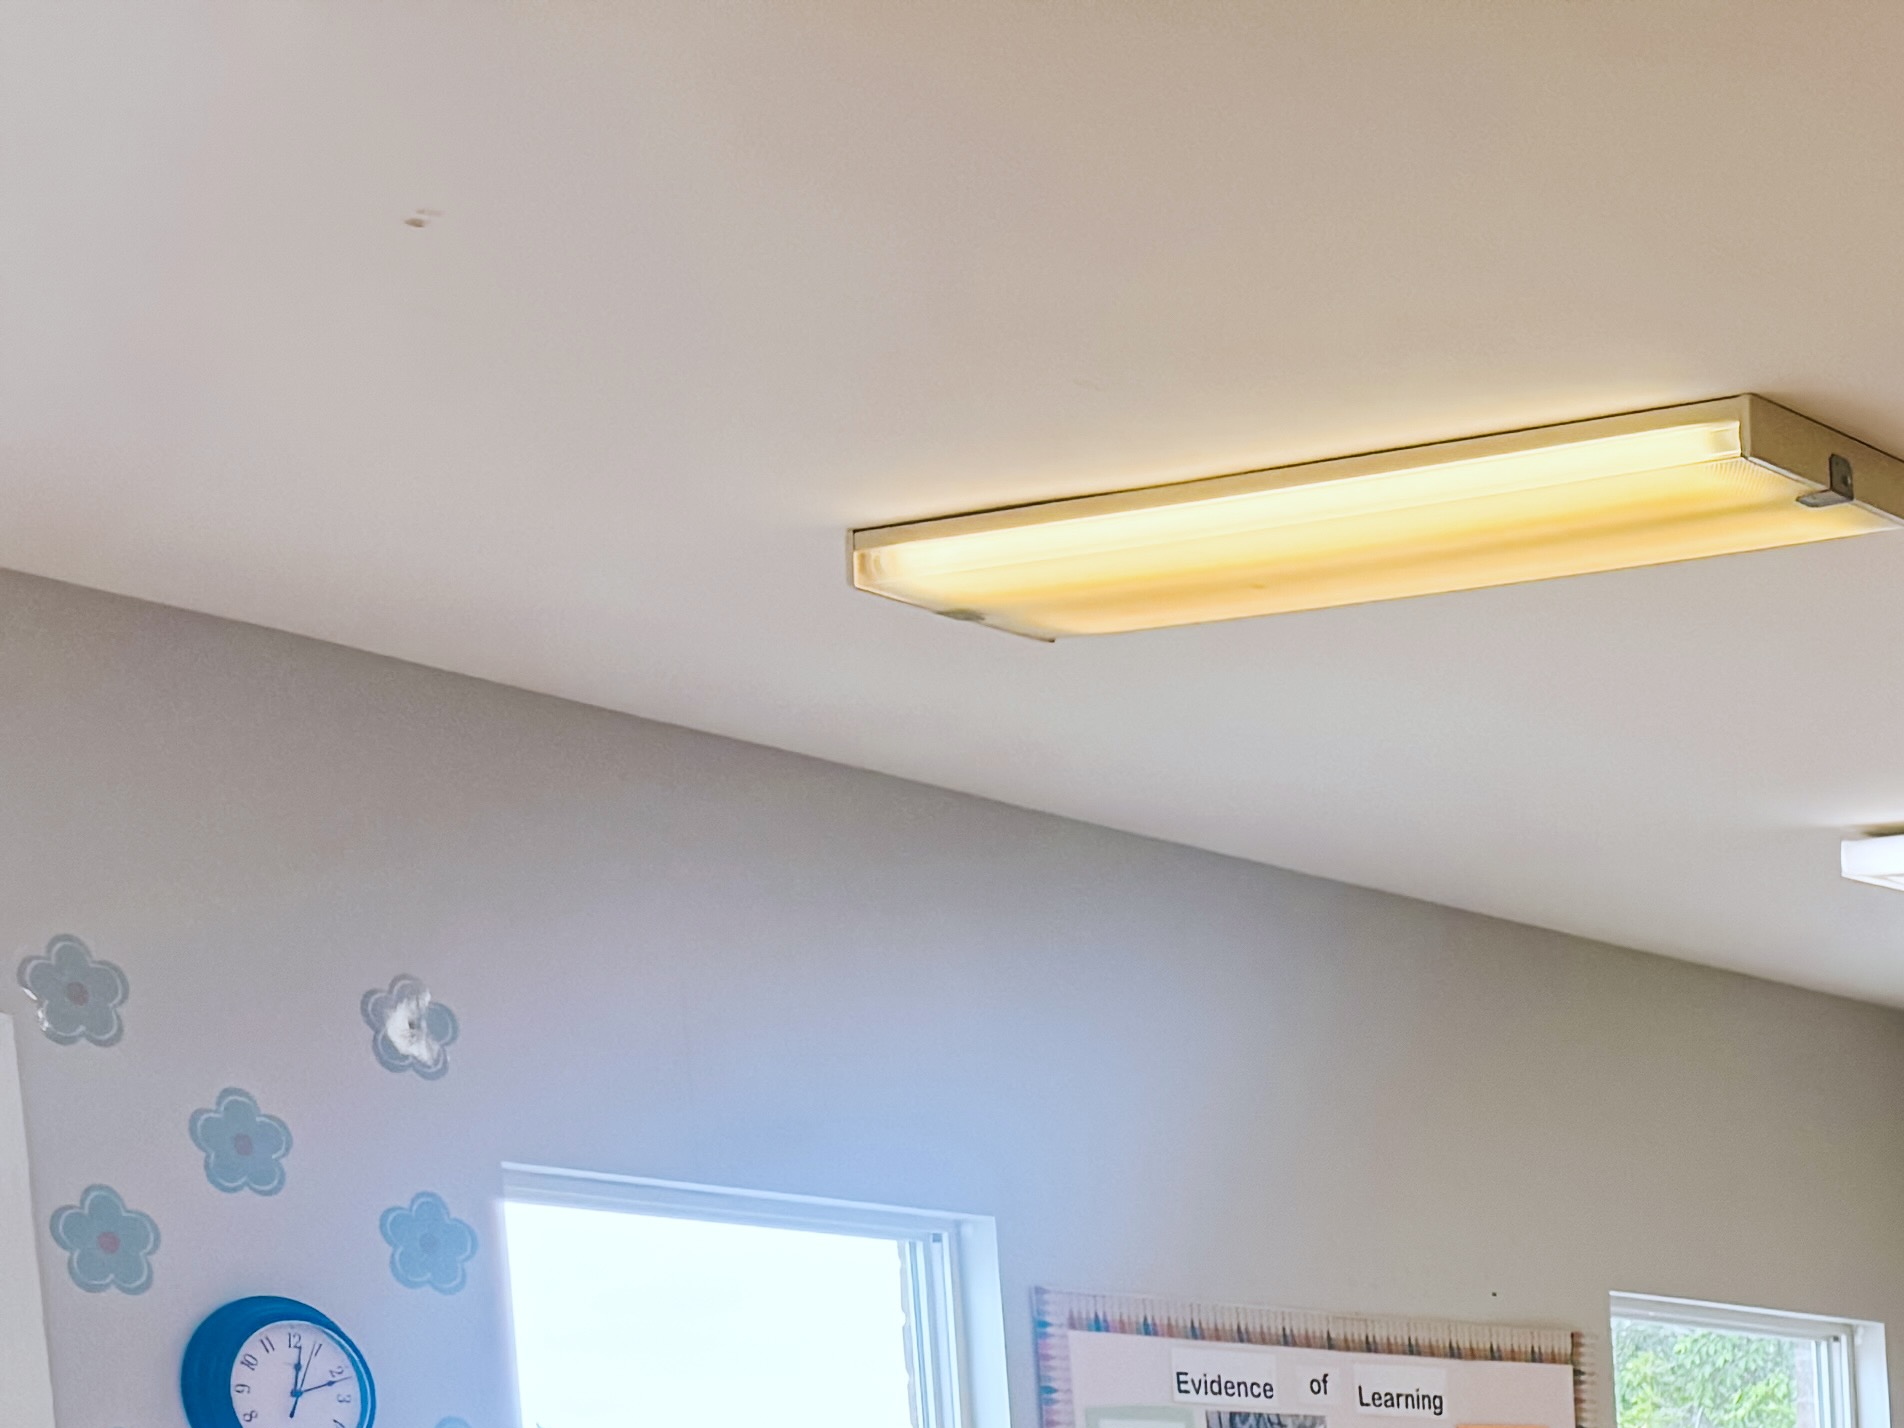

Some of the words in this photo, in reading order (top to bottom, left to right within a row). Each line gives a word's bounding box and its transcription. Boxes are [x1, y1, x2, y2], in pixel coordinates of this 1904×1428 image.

[260, 1336, 275, 1354] 11
[288, 1332, 301, 1350] 12
[240, 1353, 259, 1371] 10
[329, 1366, 344, 1378] 2
[234, 1383, 250, 1395] 9
[1176, 1371, 1274, 1400] Evidence
[1309, 1373, 1329, 1395] of
[1358, 1385, 1444, 1416] Learning
[336, 1393, 352, 1404] 3
[242, 1410, 258, 1423] 8
